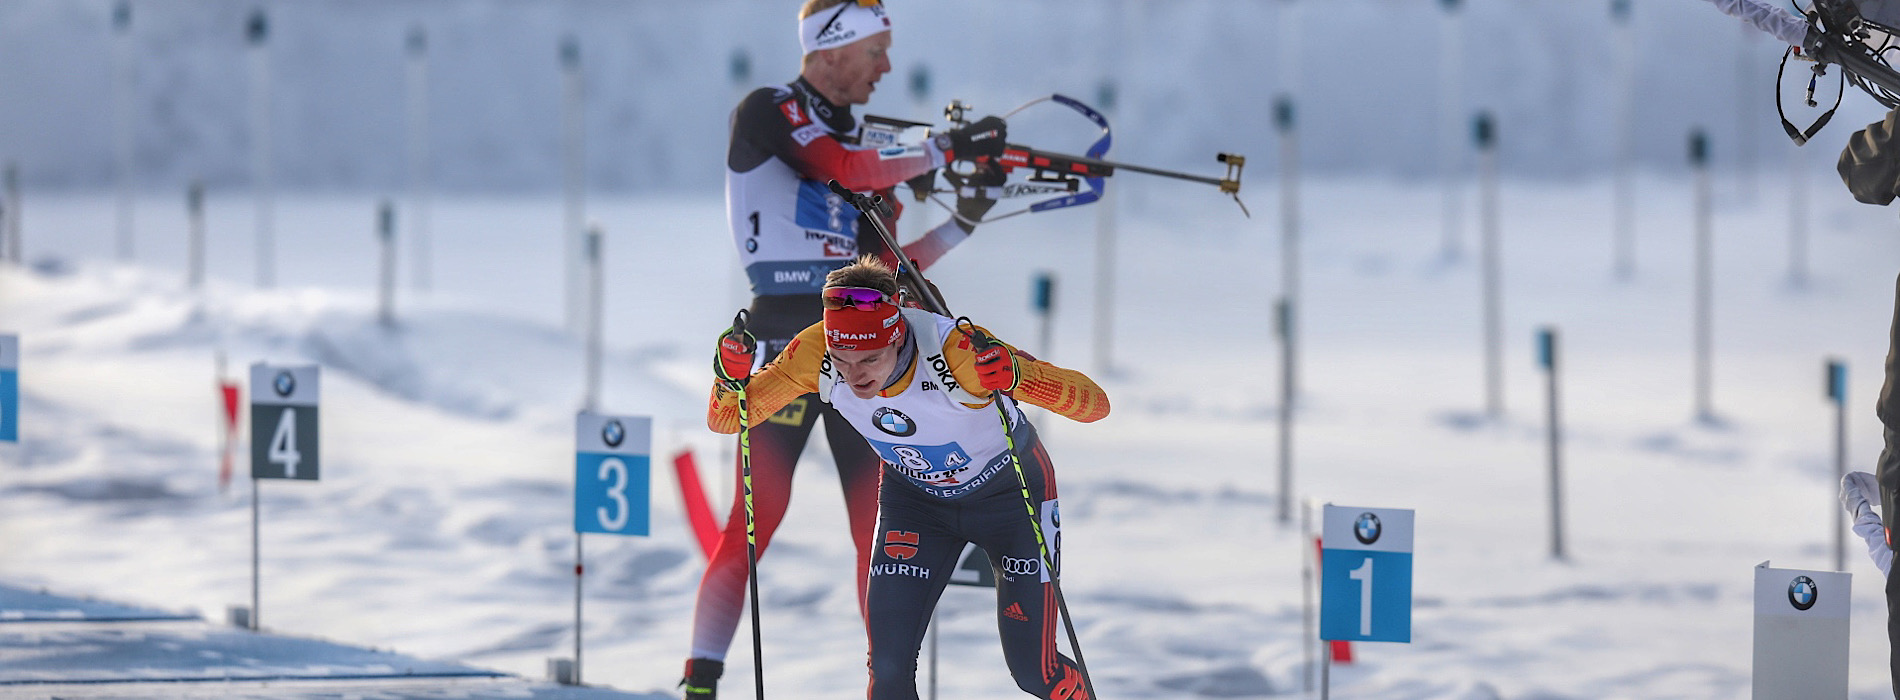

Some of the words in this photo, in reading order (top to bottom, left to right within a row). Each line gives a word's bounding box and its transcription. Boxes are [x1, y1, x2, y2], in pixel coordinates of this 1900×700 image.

[748, 210, 761, 237] 1
[774, 270, 811, 283] BMW
[267, 406, 302, 479] 4
[891, 445, 933, 472] 8
[944, 450, 968, 469] 4
[597, 457, 629, 532] 3
[871, 563, 930, 580] WÜRTH
[1349, 557, 1373, 637] 1
[1003, 609, 1029, 622] adidas
